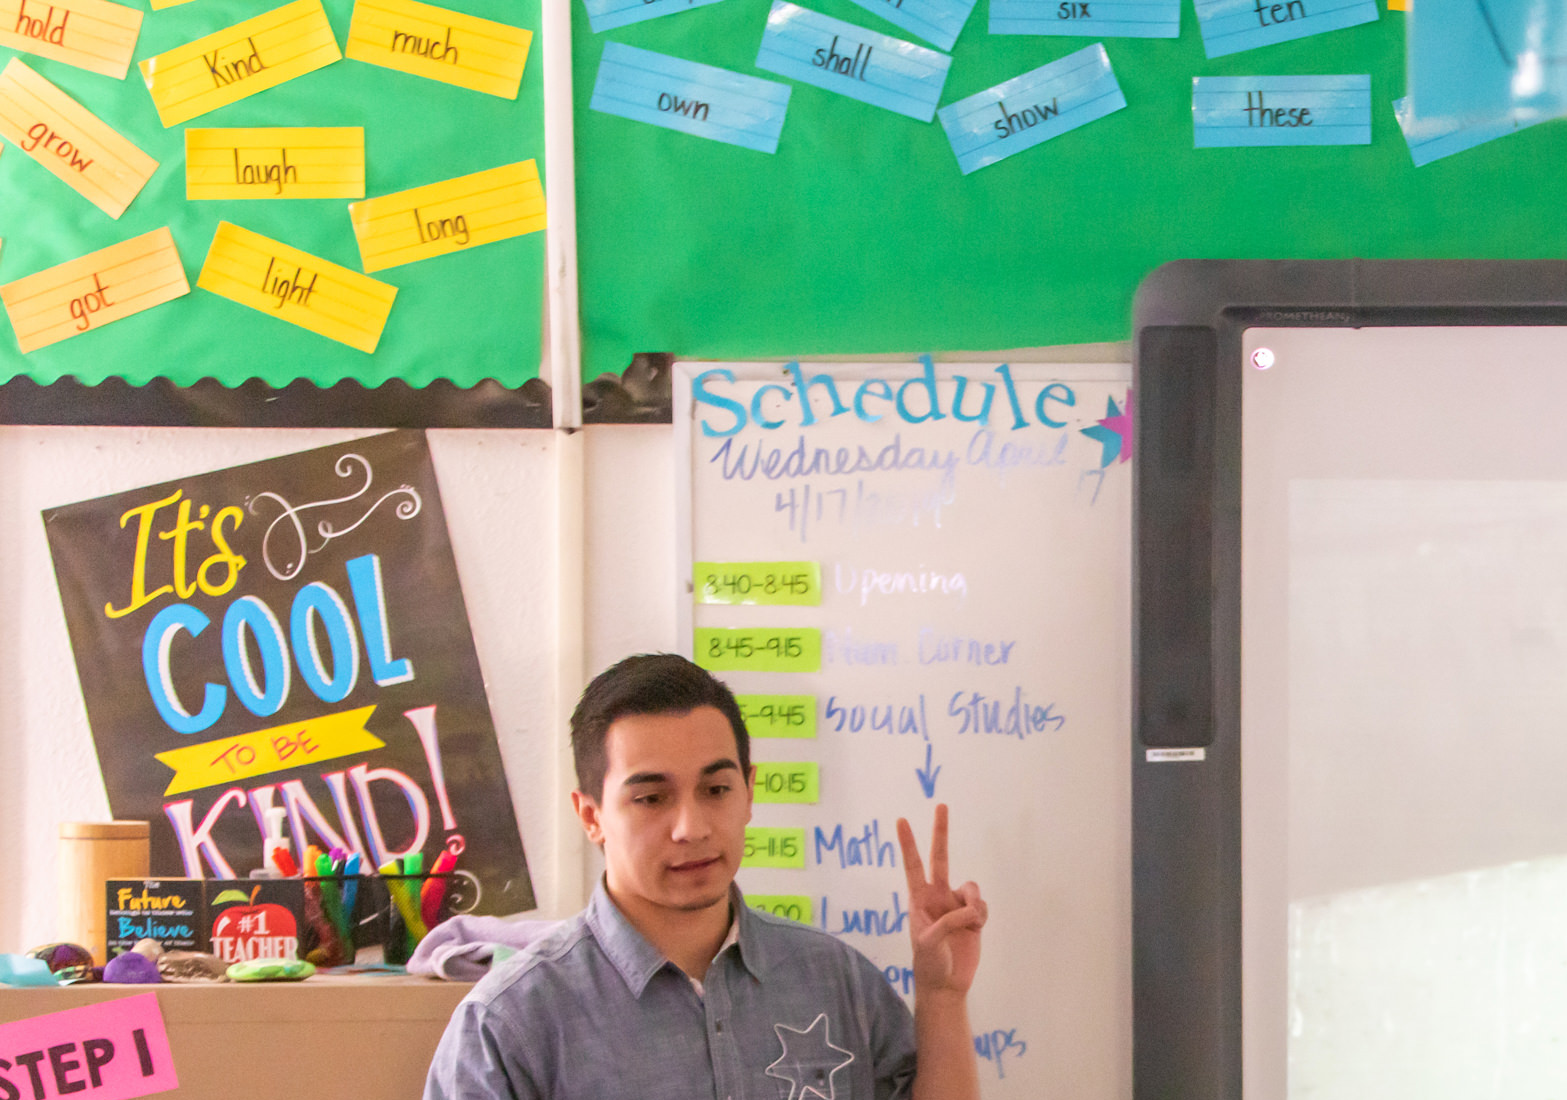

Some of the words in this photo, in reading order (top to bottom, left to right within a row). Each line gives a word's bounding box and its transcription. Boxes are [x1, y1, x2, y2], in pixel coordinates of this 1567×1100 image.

[15, 6, 69, 46] hold
[1057, 0, 1092, 19] six
[1253, 0, 1308, 27] ten
[202, 37, 268, 88] Kind
[391, 27, 459, 65] much
[812, 35, 873, 82] shall
[657, 92, 710, 122] own
[994, 97, 1060, 141] show
[1243, 90, 1314, 129] these
[20, 122, 95, 173] grow
[234, 148, 297, 194] laugh
[414, 208, 470, 245] long
[69, 273, 115, 331] got
[261, 257, 318, 309] light
[692, 355, 1077, 438] Schedule
[710, 434, 960, 494] Wednesday
[105, 488, 247, 619] It's
[142, 553, 415, 734] COOL
[948, 686, 1067, 740] Studies
[210, 744, 256, 775] TO
[271, 730, 319, 761] BE
[814, 819, 896, 869] Math
[117, 887, 186, 911] Future
[118, 916, 194, 939] Believe
[237, 911, 270, 935] #1
[210, 936, 299, 964] TEACHER
